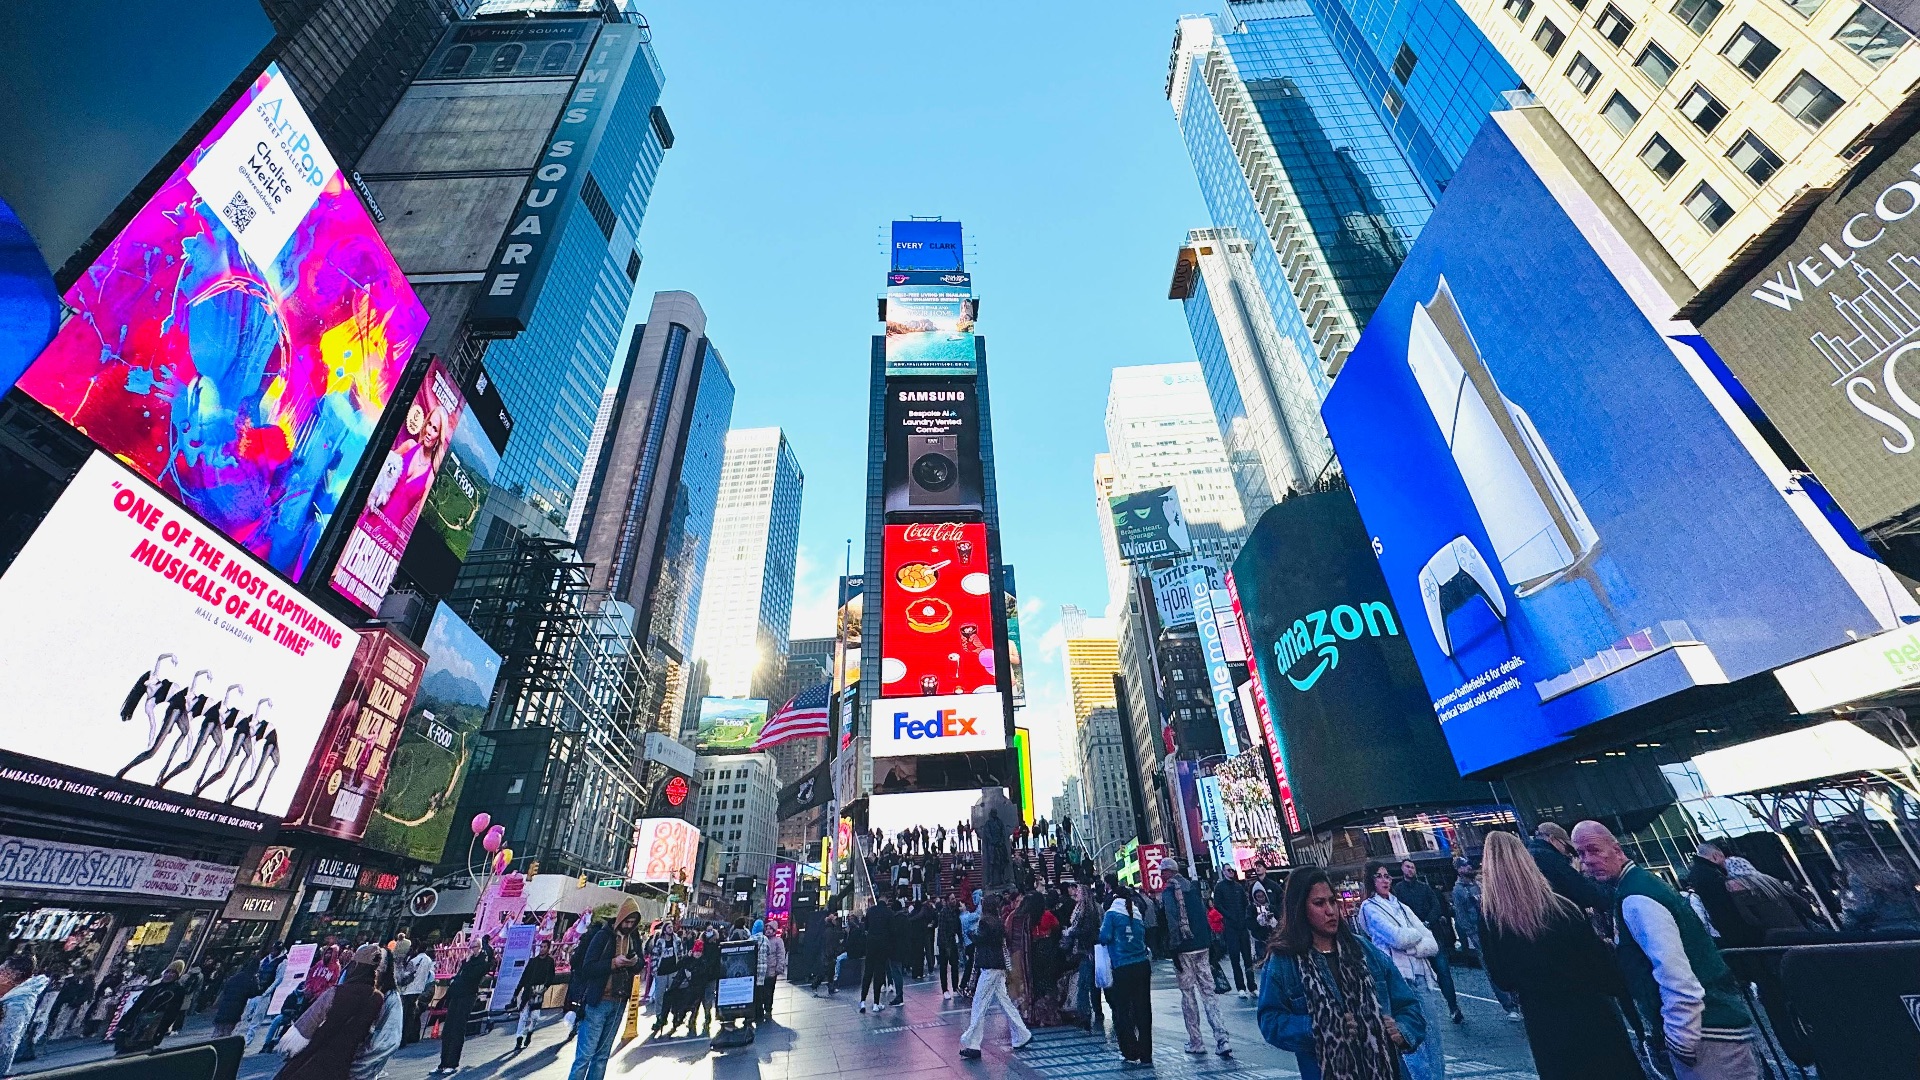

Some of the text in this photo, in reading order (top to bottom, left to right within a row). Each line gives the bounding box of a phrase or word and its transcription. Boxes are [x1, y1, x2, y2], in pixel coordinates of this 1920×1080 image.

[563, 34, 622, 123] TIMES
[256, 106, 307, 180] STREET GALLERY
[262, 98, 324, 187] ArtPop
[247, 155, 282, 204] Meikle
[256, 141, 292, 194] Chalice
[488, 140, 576, 296] SQUARE
[1751, 160, 1920, 312] WELCO
[899, 391, 966, 402] SAMSUNG
[908, 410, 941, 418] Bespoke
[453, 466, 475, 499] K-FOOD
[161, 519, 192, 549] OF
[189, 537, 226, 573] THE
[222, 555, 268, 600] MOST
[266, 589, 343, 649] CAPTIVATING
[341, 526, 399, 598] VERSAILLES
[1158, 564, 1189, 589] LITTLE
[130, 538, 226, 607] MUSICALS
[225, 594, 250, 622] OF
[245, 610, 274, 638] ALL
[195, 606, 212, 621] MAIL
[220, 619, 254, 644] GUARDIAN
[1194, 582, 1225, 663] mobile
[1274, 601, 1399, 676] amazon
[1489, 668, 1501, 680] for
[1500, 655, 1526, 674] details.
[1457, 698, 1474, 714] Stand
[1473, 691, 1488, 706] sold
[1486, 677, 1521, 700] separately.
[427, 722, 454, 749] K-FOOD
[893, 709, 978, 740] FedEx
[1260, 704, 1288, 789] CHOCOLATE
[0, 767, 64, 790] AMBASSADOR
[62, 781, 98, 797] THEATRE
[103, 790, 122, 802] 49TH
[143, 799, 181, 814] BROADWAY
[183, 808, 196, 818] NO
[195, 810, 210, 820] FEES
[209, 812, 219, 821] AT
[217, 814, 229, 824] THE
[228, 817, 239, 826] BOX
[238, 819, 258, 830] OFFICE
[317, 858, 361, 878] BLUE FIN
[772, 866, 792, 908] tkts
[1145, 848, 1163, 889] tkts
[242, 898, 273, 912] HEYTEA
